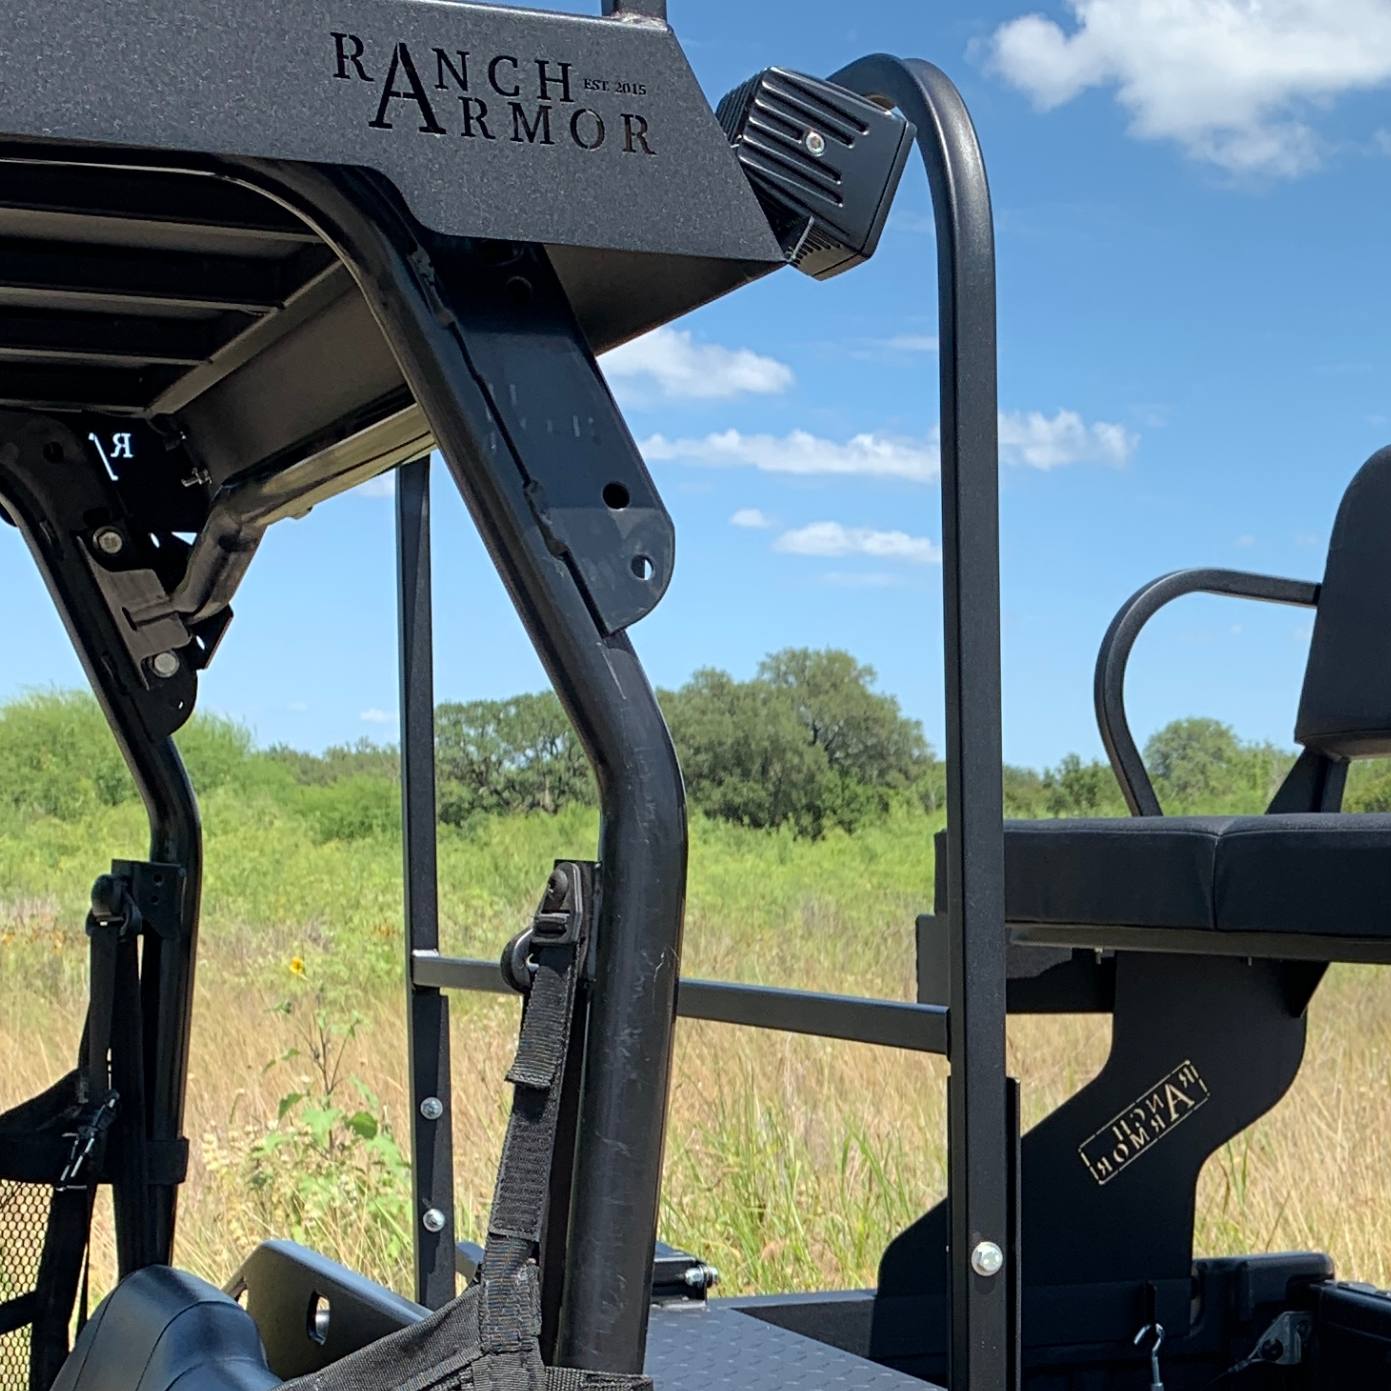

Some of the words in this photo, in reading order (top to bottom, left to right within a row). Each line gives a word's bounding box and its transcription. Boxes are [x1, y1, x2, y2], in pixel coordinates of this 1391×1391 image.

[330, 32, 575, 134] RANCH
[615, 80, 647, 95] 2015
[368, 42, 657, 156] ARMOR
